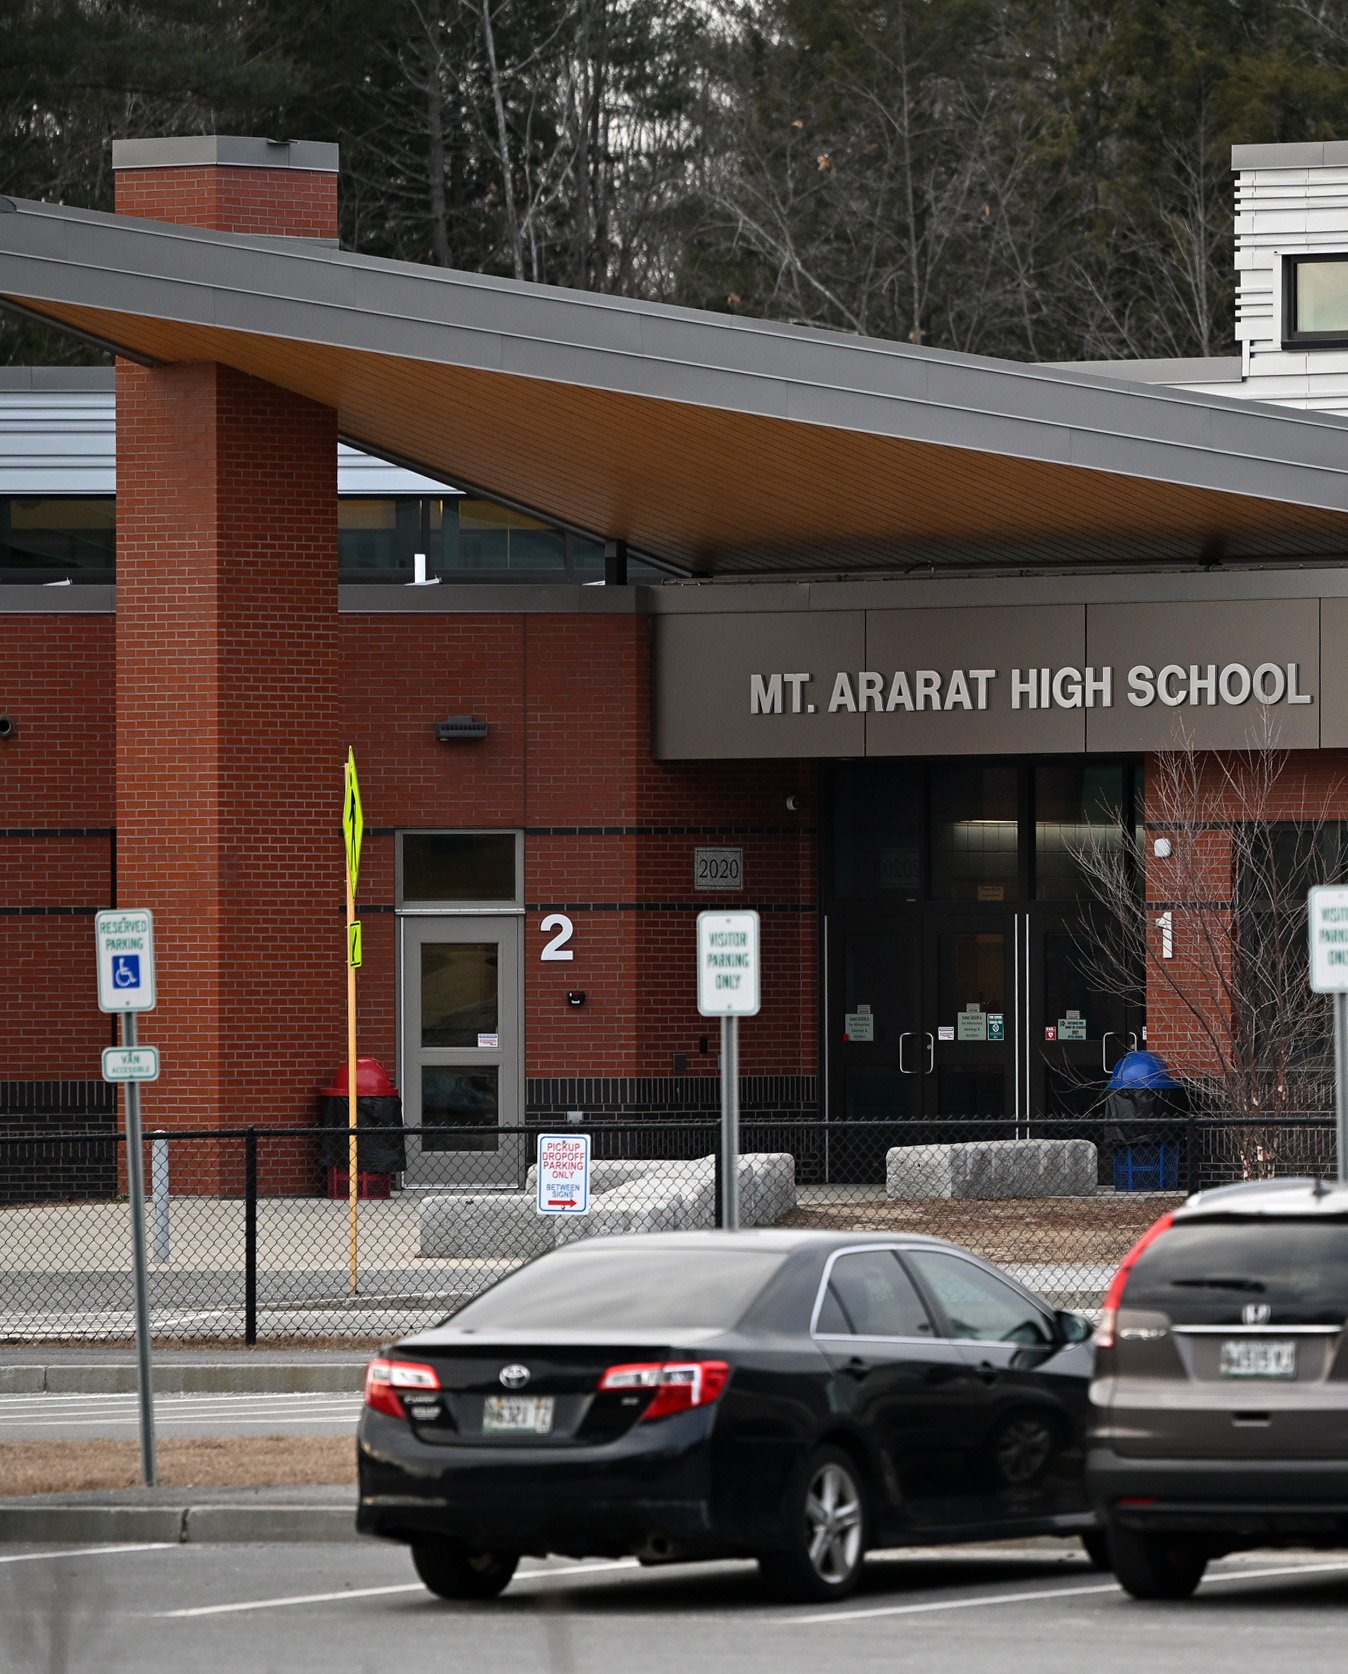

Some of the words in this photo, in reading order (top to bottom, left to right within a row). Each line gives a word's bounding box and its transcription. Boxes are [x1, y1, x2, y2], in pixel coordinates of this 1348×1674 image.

[750, 673, 816, 715] MT.
[827, 669, 996, 713] ARARAT
[1010, 666, 1112, 710] HIGH
[1126, 662, 1313, 707] SCHOOL
[699, 859, 739, 879] 2020
[100, 920, 147, 933] RESERVED
[540, 913, 574, 961] 2
[709, 932, 747, 947] VISITOR
[1155, 911, 1173, 959] 1
[105, 938, 144, 950] PARKING
[707, 954, 750, 968] PARKING
[715, 974, 742, 990] ONLY
[121, 1056, 140, 1064] VAN
[547, 1143, 581, 1151] PICKUP
[542, 1152, 585, 1161] DROPOFF
[543, 1162, 583, 1170] PARKING
[552, 1171, 574, 1179] ONLY
